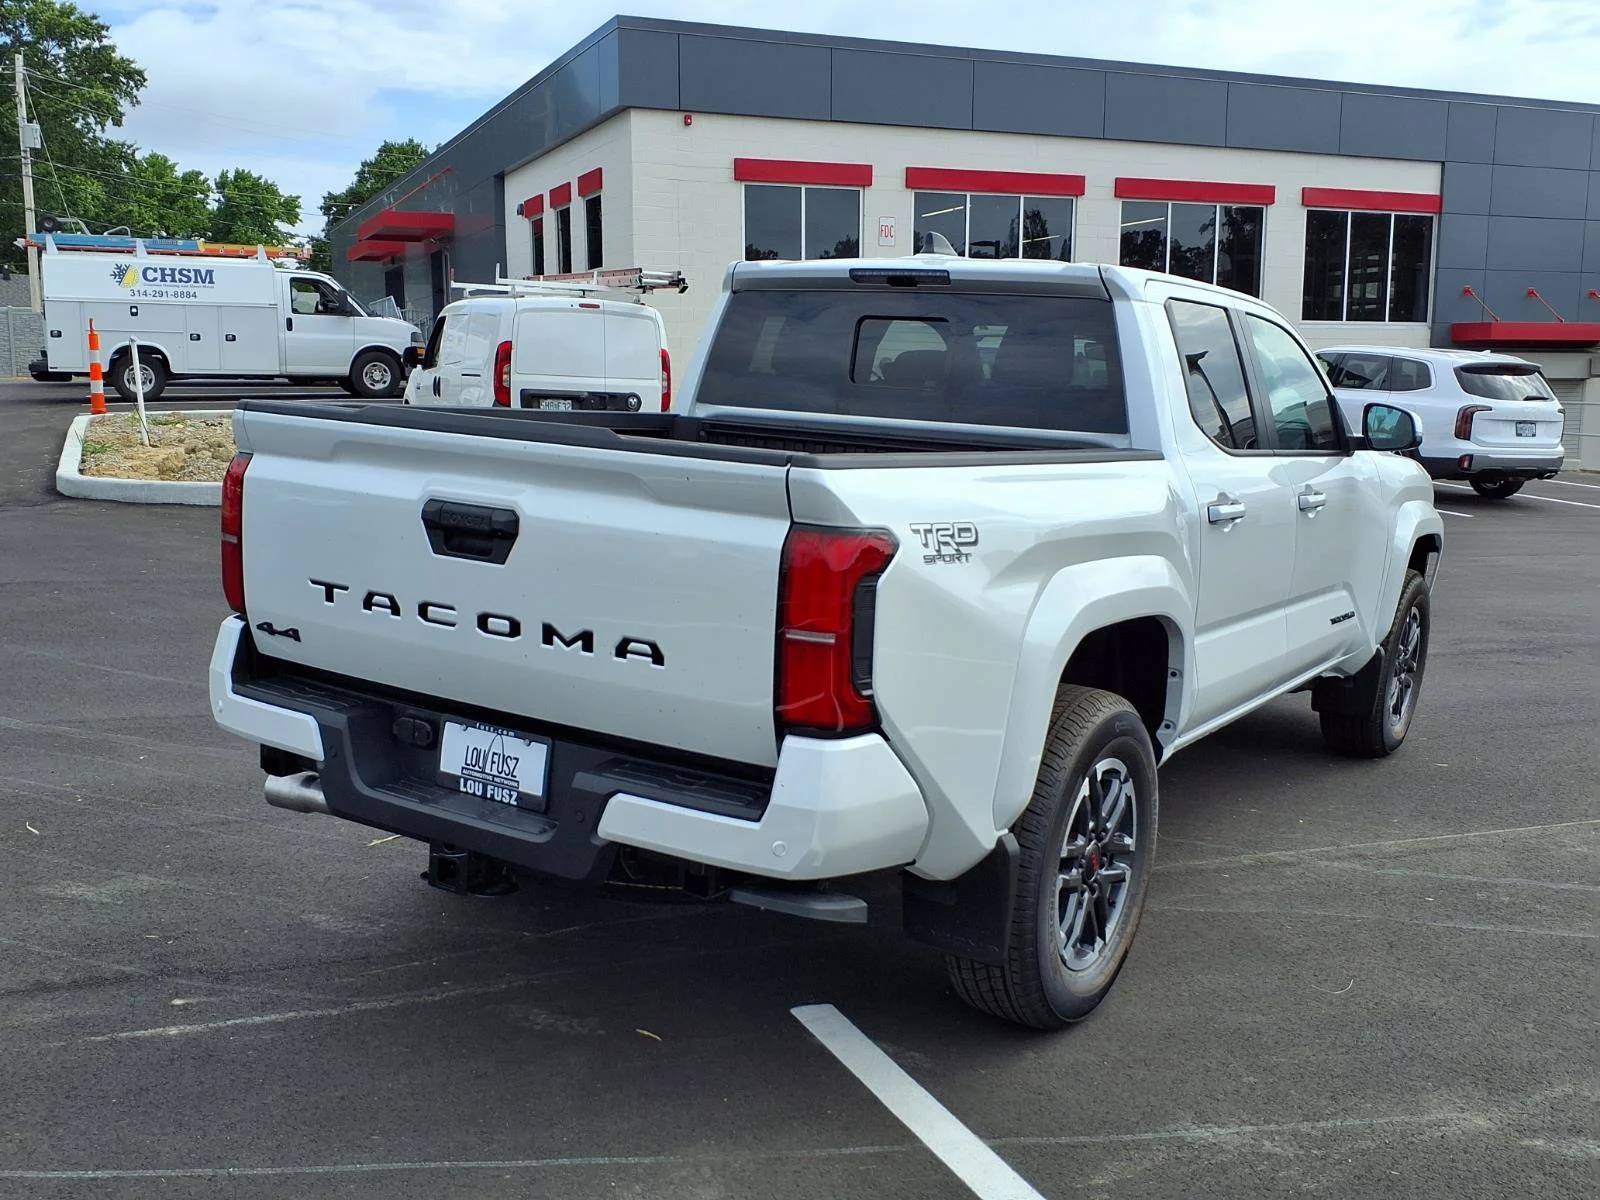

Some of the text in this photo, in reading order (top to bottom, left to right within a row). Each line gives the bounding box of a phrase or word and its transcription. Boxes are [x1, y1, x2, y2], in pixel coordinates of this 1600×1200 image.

[881, 224, 894, 238] FDC
[142, 267, 215, 285] CHSM
[130, 289, 197, 299] 314-291-8884
[909, 521, 979, 555] TRD
[923, 553, 971, 565] SPORT
[308, 577, 665, 667] TACOMA
[465, 745, 520, 779] LOU FUSZ
[462, 768, 519, 788] AUTOMOTIVE NETWORK
[459, 777, 518, 806] LOU FUSZ
